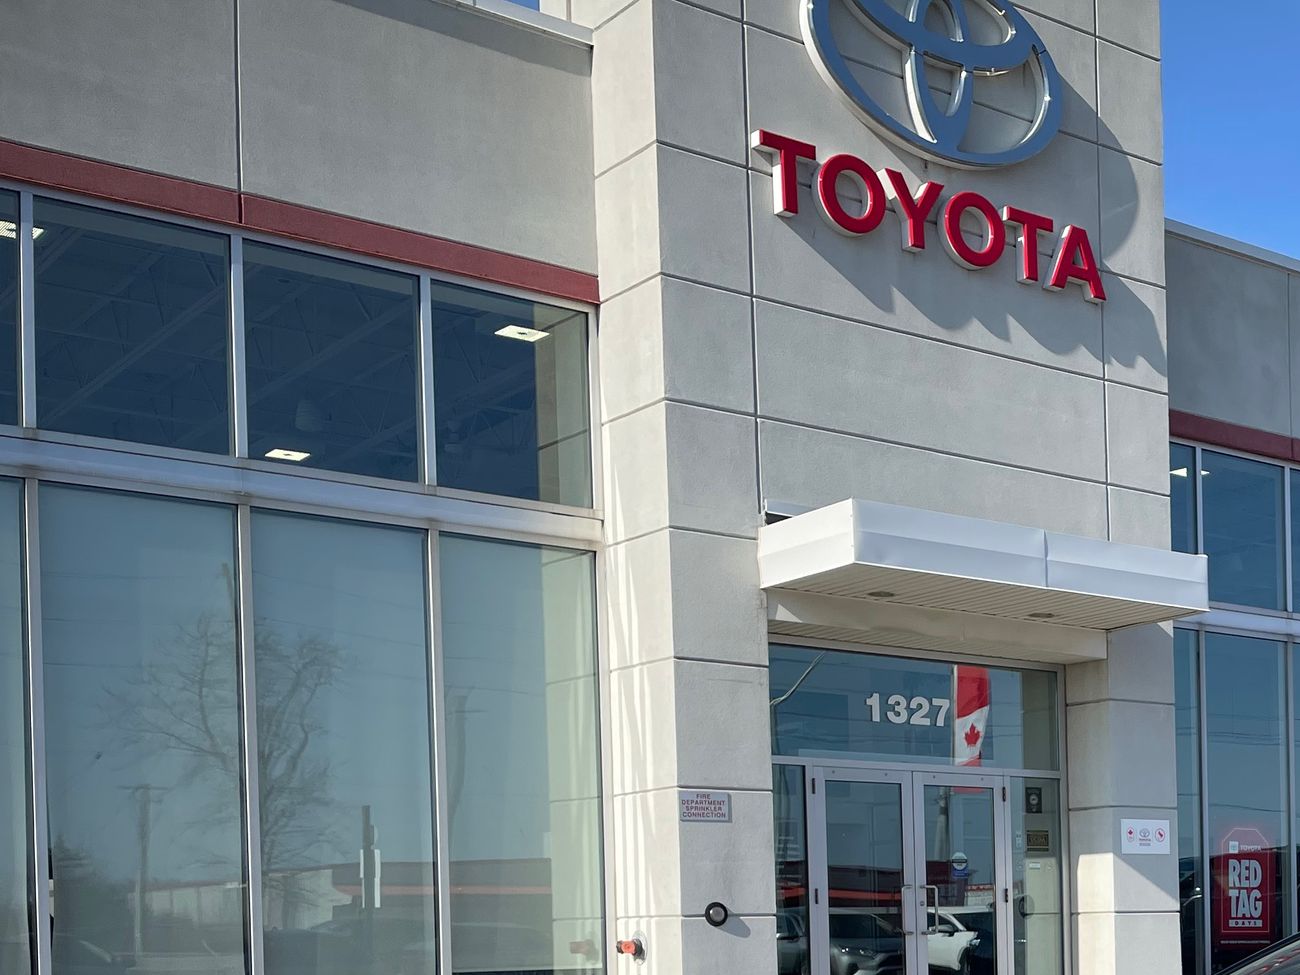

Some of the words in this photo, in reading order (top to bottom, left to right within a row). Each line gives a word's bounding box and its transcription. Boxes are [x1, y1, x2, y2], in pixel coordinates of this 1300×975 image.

[751, 129, 1107, 304] TOYOTA
[865, 692, 951, 728] 1327
[1228, 858, 1263, 888] RED
[1228, 889, 1263, 918] TAG
